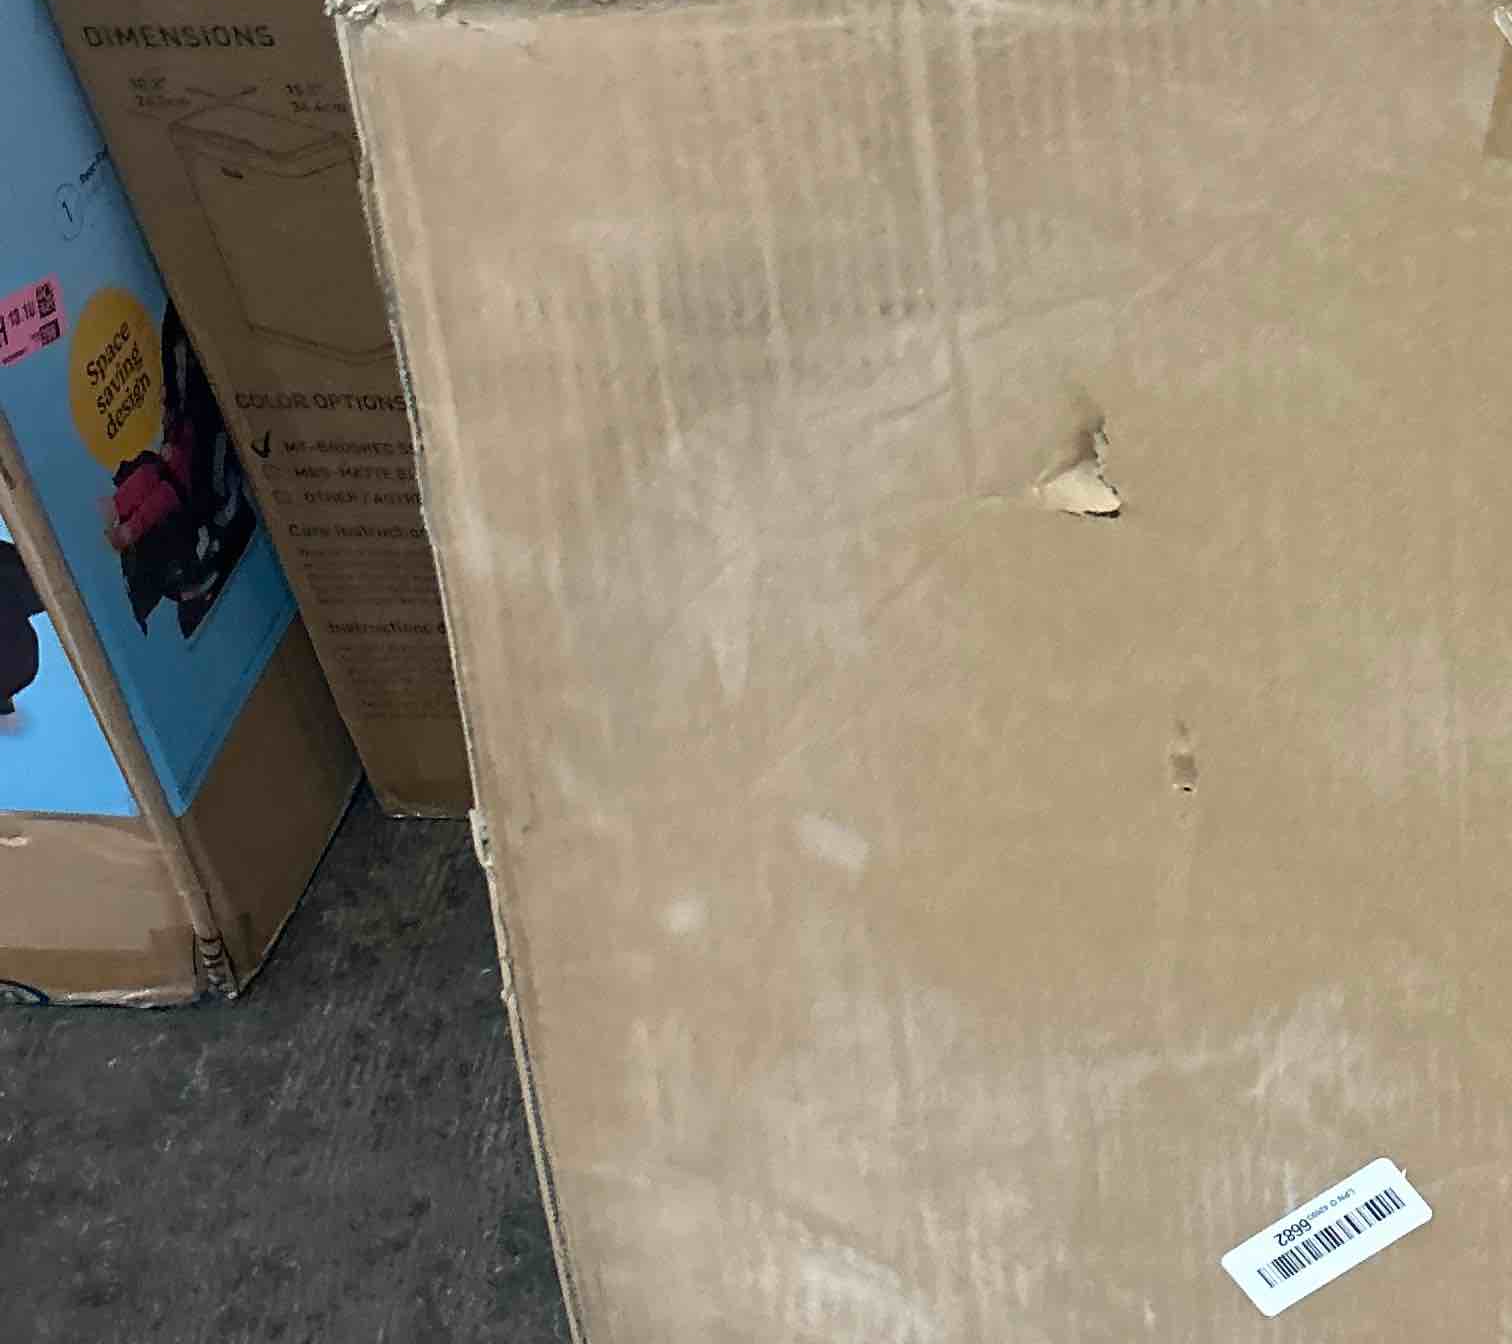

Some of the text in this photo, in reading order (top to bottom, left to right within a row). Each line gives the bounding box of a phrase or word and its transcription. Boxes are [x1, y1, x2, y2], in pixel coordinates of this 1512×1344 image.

[82, 25, 276, 49] DIMENSIONS
[85, 321, 131, 386] Space
[96, 341, 145, 415] saving
[105, 372, 152, 440] design
[1273, 1217, 1312, 1248] 6682
